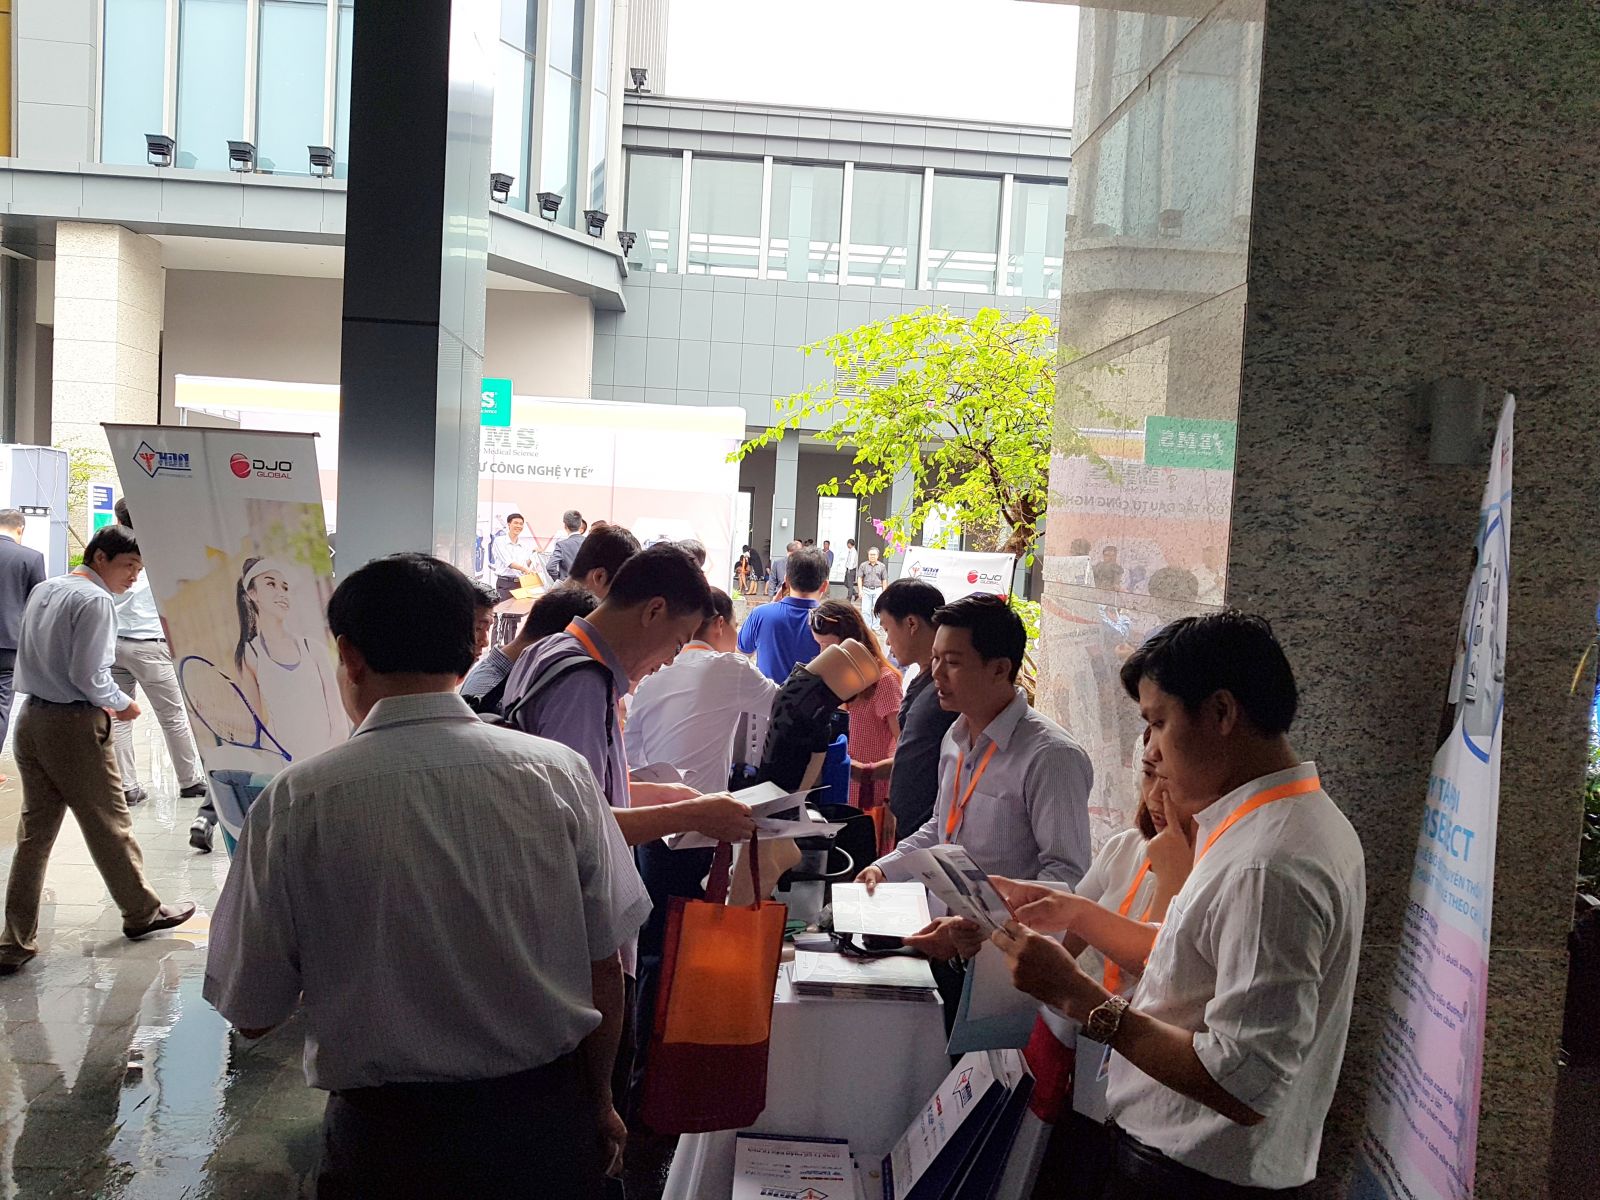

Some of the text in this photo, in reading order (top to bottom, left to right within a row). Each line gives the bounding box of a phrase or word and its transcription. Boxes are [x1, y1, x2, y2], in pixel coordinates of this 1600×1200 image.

[483, 447, 539, 458] Medical Science
[252, 459, 292, 472] DJO
[489, 462, 525, 475] CÔNG
[527, 464, 561, 480] NGHỆ
[563, 466, 572, 478] Y
[256, 471, 292, 480] GLOBAL
